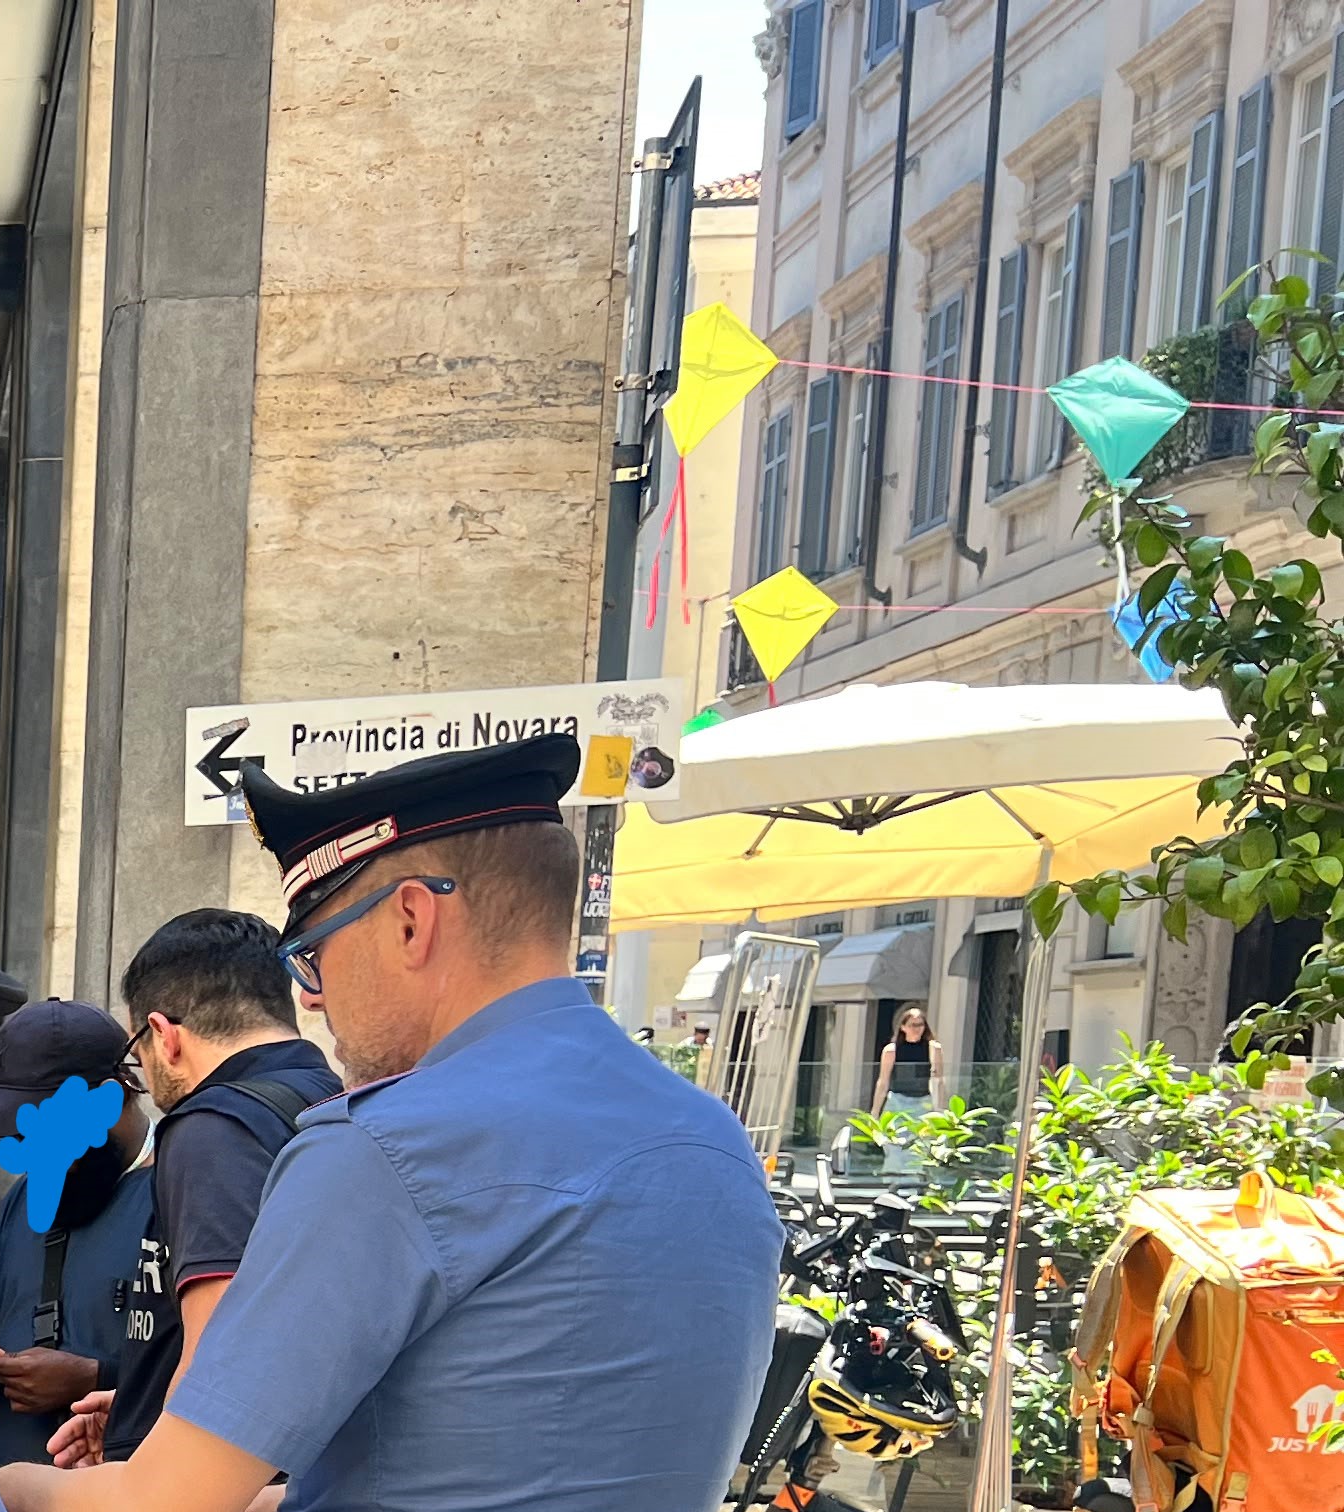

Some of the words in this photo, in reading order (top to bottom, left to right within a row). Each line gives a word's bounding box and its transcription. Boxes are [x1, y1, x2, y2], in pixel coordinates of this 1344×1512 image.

[437, 721, 461, 749] di
[472, 712, 580, 747] Novara
[127, 1309, 154, 1341] ORO
